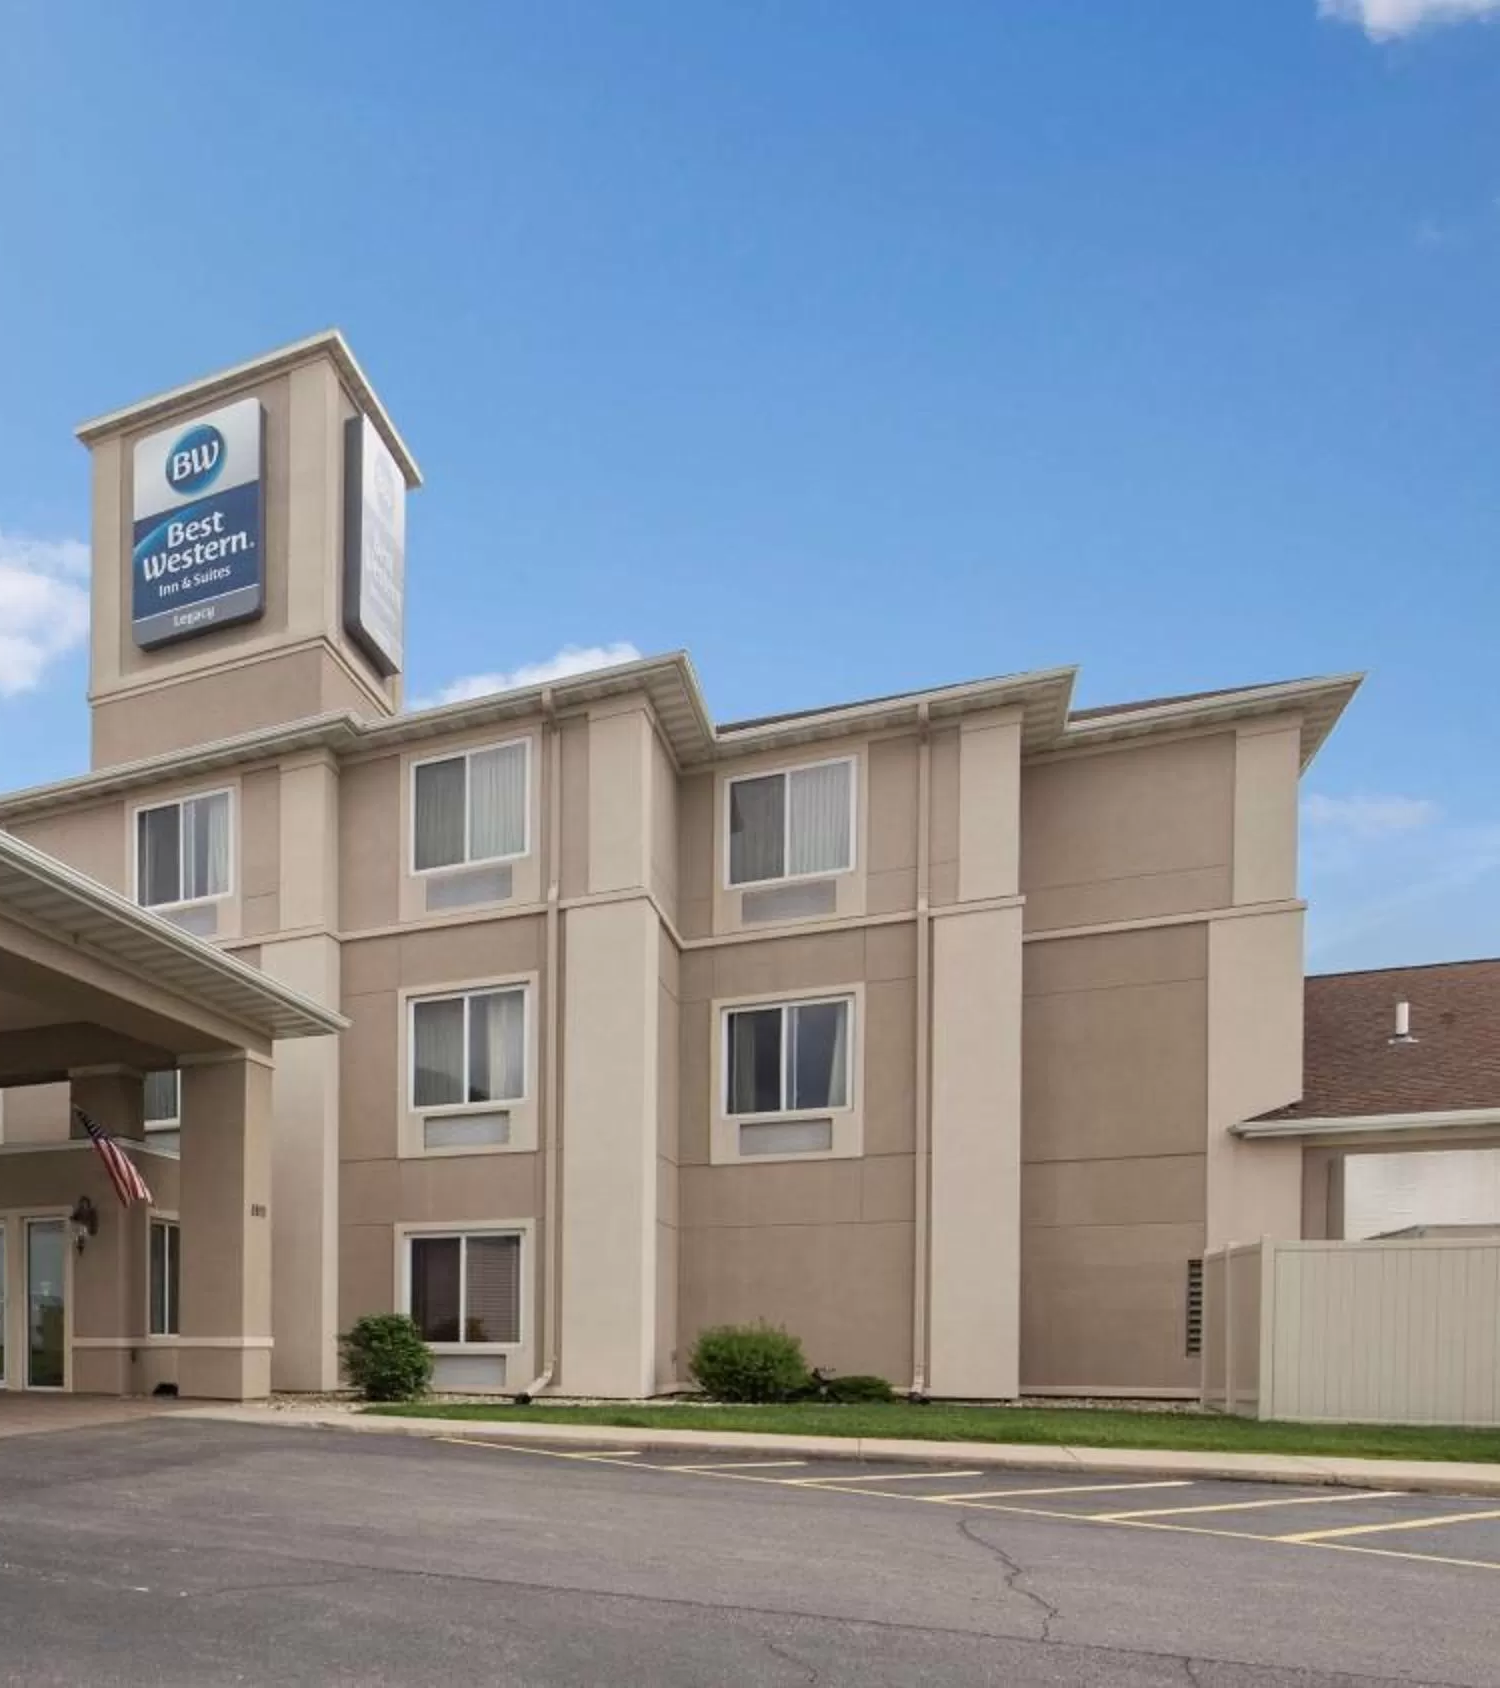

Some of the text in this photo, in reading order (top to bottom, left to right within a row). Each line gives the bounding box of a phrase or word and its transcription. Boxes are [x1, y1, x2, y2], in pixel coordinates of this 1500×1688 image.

[173, 440, 219, 481] BW
[167, 511, 224, 548] Best
[159, 565, 232, 598] Inn & Suites
[173, 606, 215, 627] Legacy
